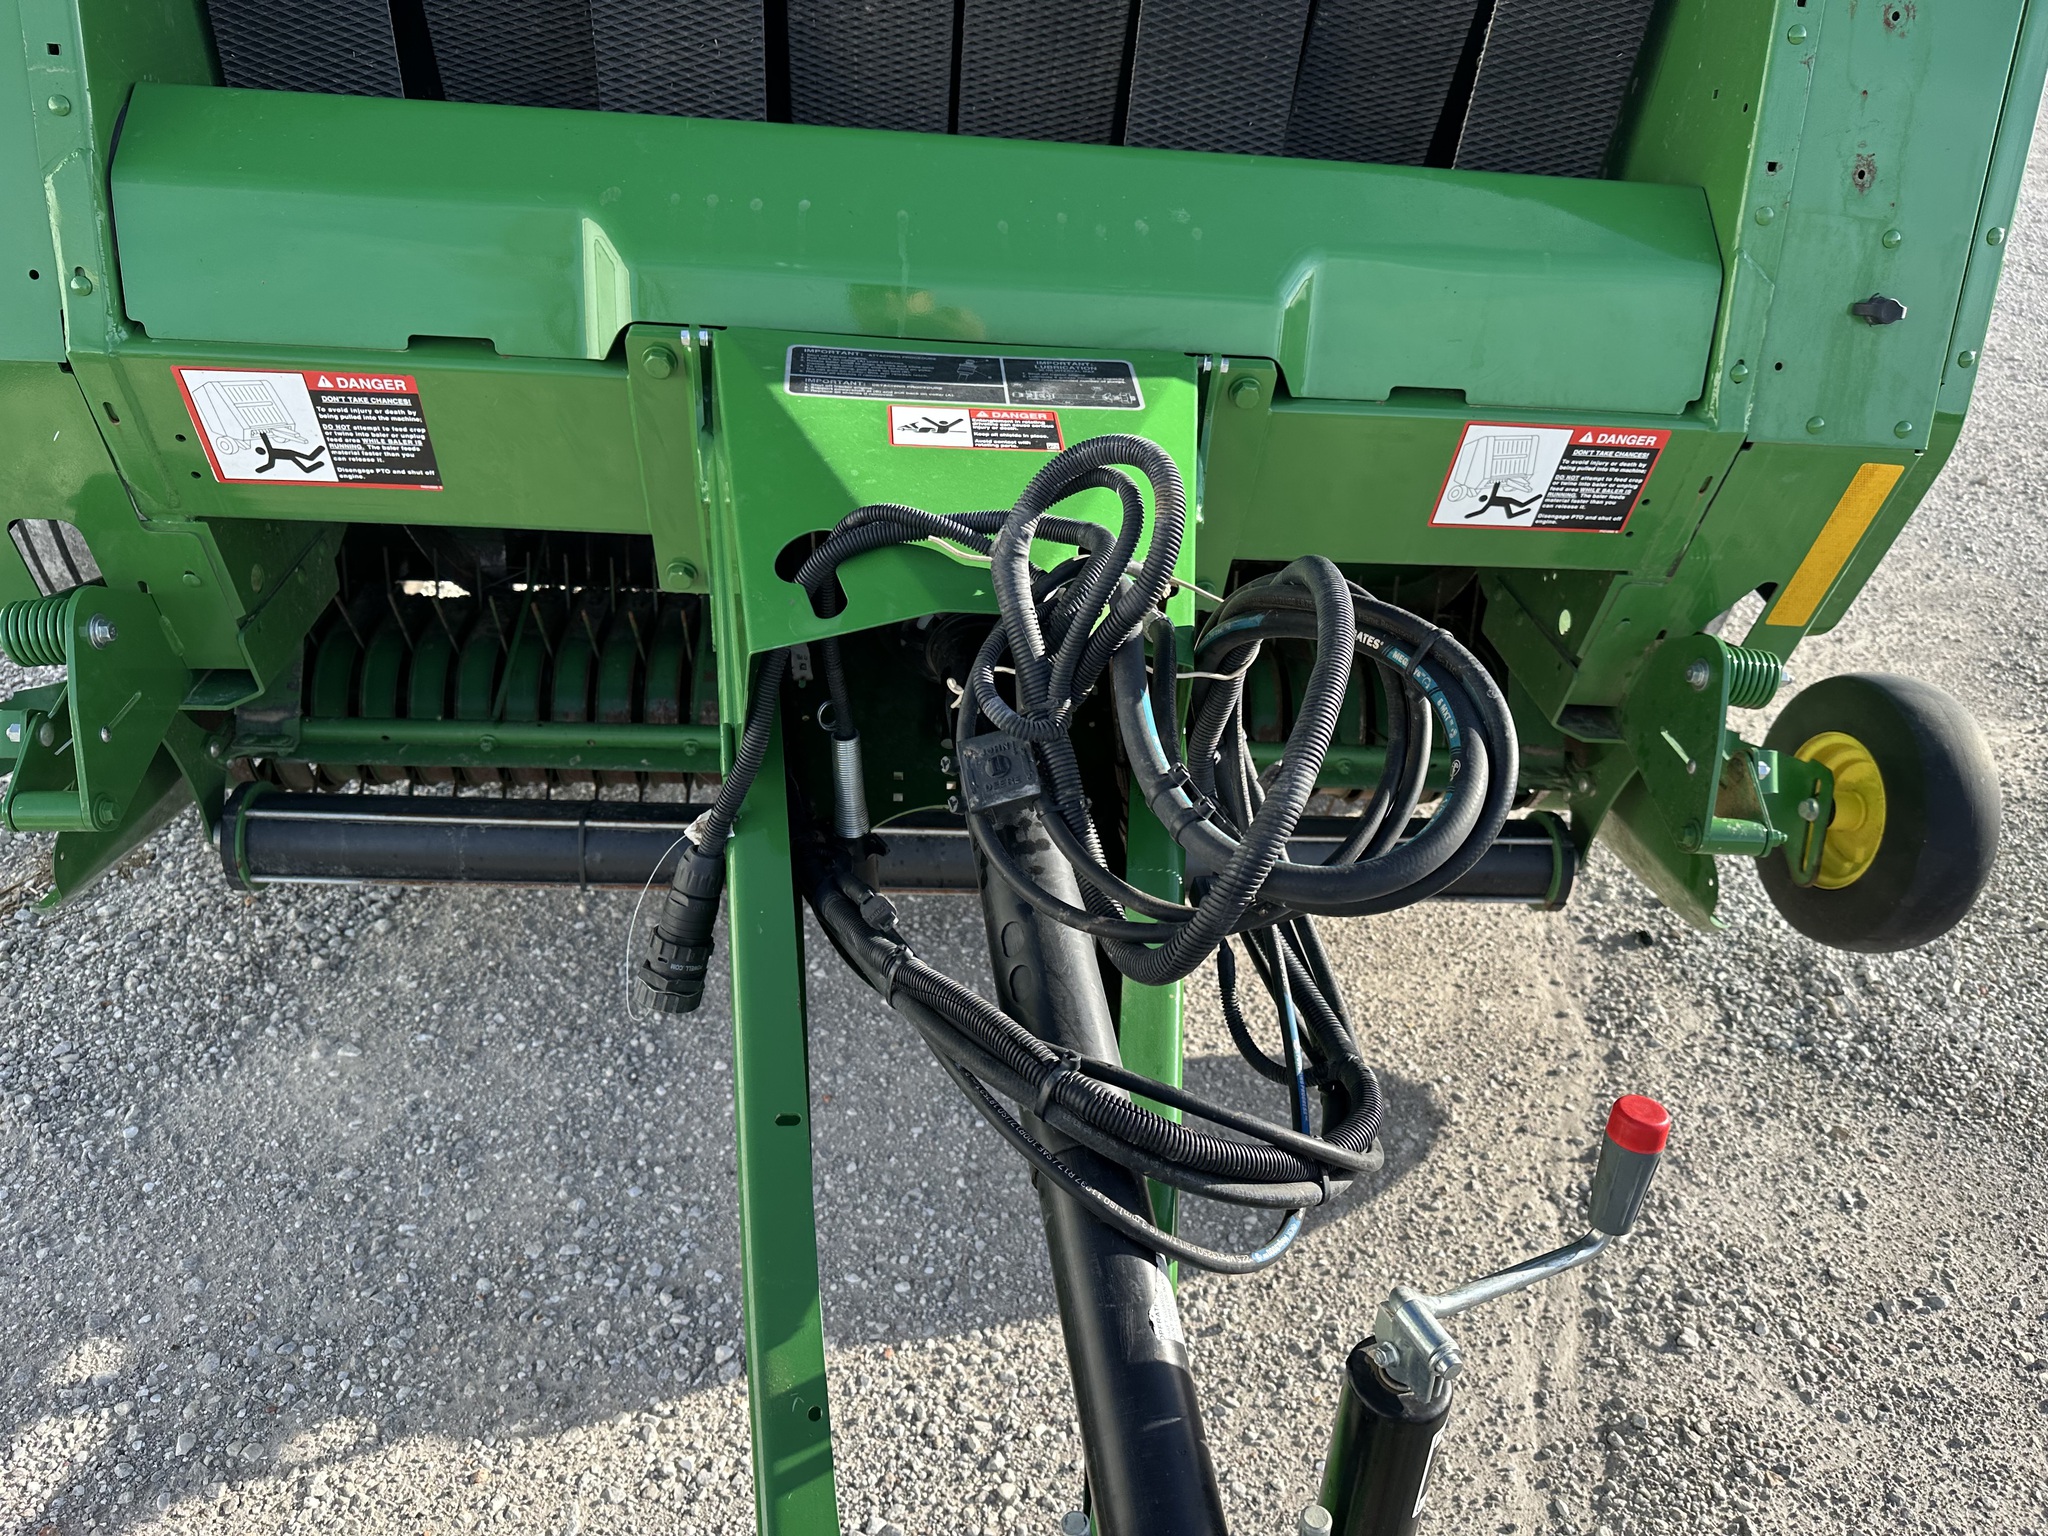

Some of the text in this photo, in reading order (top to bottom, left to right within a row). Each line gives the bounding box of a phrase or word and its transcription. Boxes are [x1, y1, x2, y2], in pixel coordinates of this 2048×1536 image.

[336, 377, 407, 390] DANGER
[804, 378, 866, 386] IMPORTANT:
[321, 395, 345, 403] DON'T
[371, 397, 411, 405] CHANCES!
[1596, 433, 1657, 446] DANGER
[980, 741, 1010, 756] JOHN
[985, 777, 1020, 791] DEERE
[1038, 1148, 1053, 1160] SAE
[1057, 1164, 1075, 1178] R17
[1103, 1199, 1118, 1211] ISO
